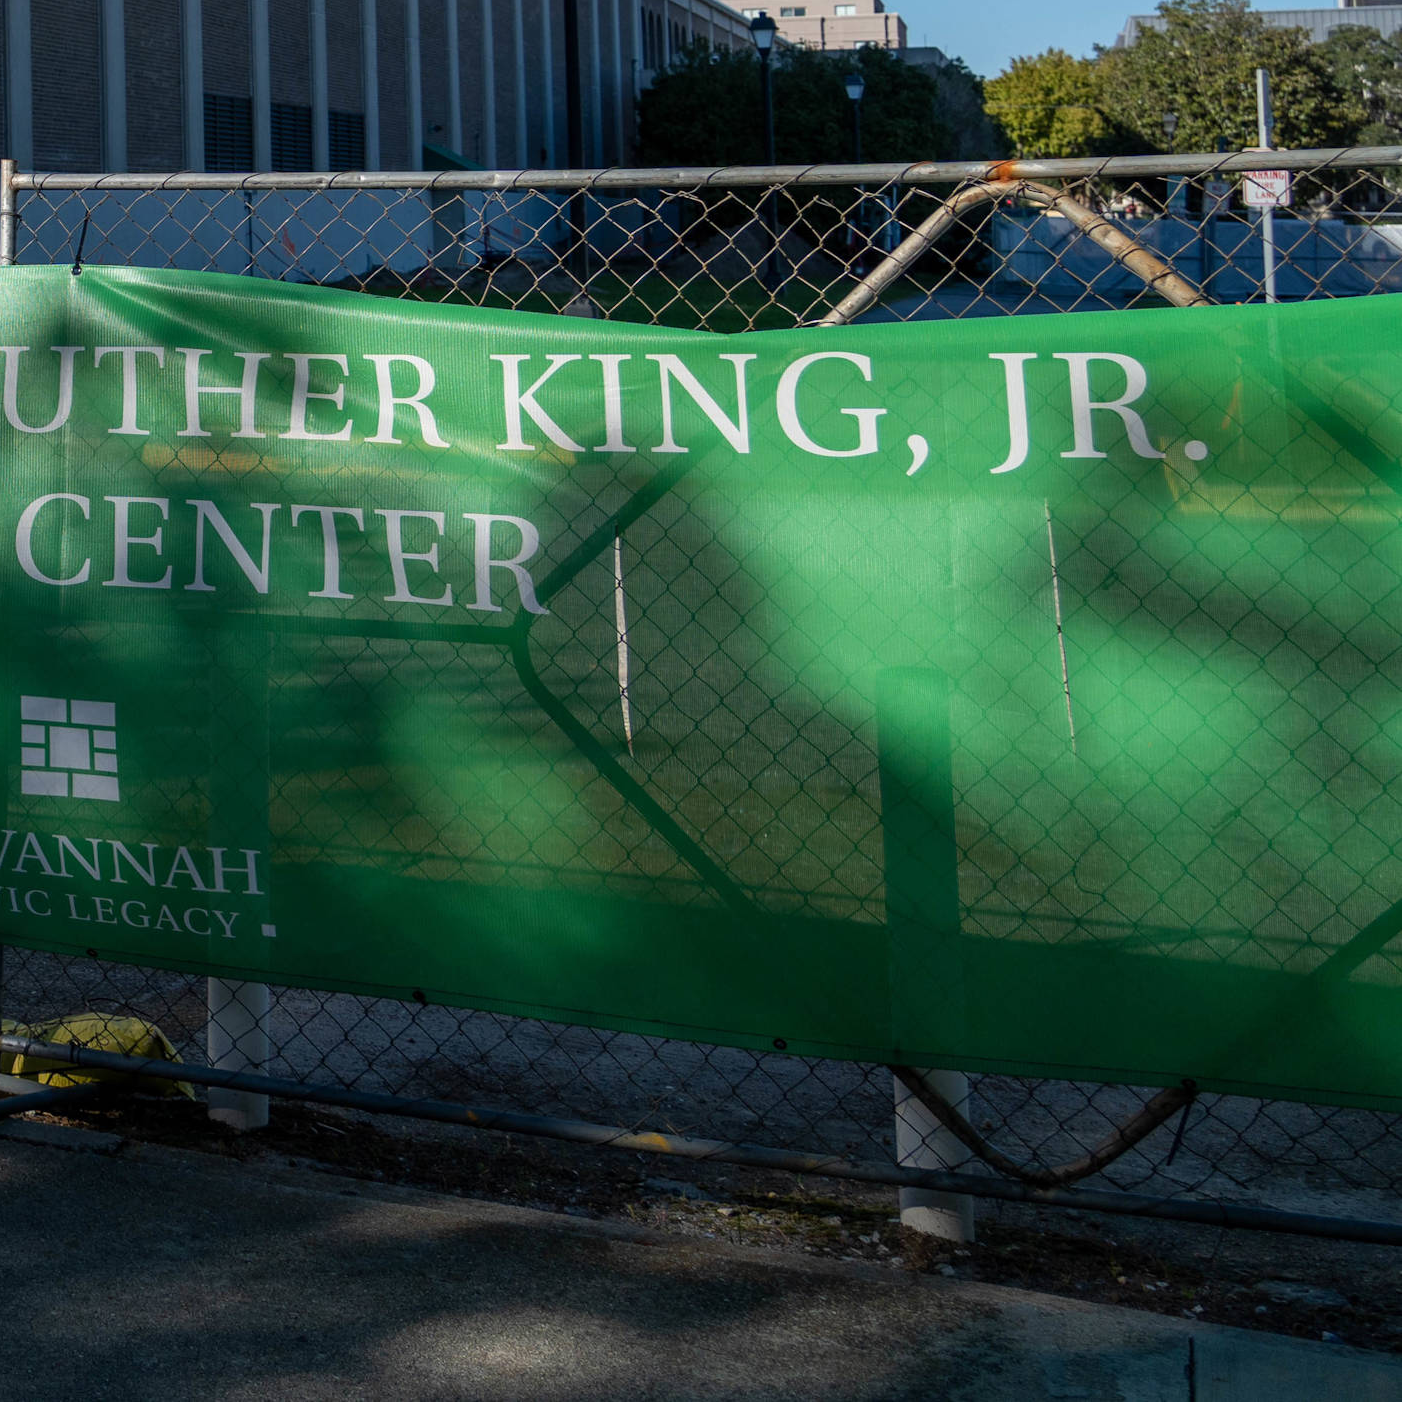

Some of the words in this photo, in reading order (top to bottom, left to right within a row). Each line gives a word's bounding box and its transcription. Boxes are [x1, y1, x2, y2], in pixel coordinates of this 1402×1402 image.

[489, 350, 930, 478] KING,
[988, 352, 1209, 475] JR.
[14, 491, 550, 616] CENTER
[65, 893, 240, 939] LEGACY
